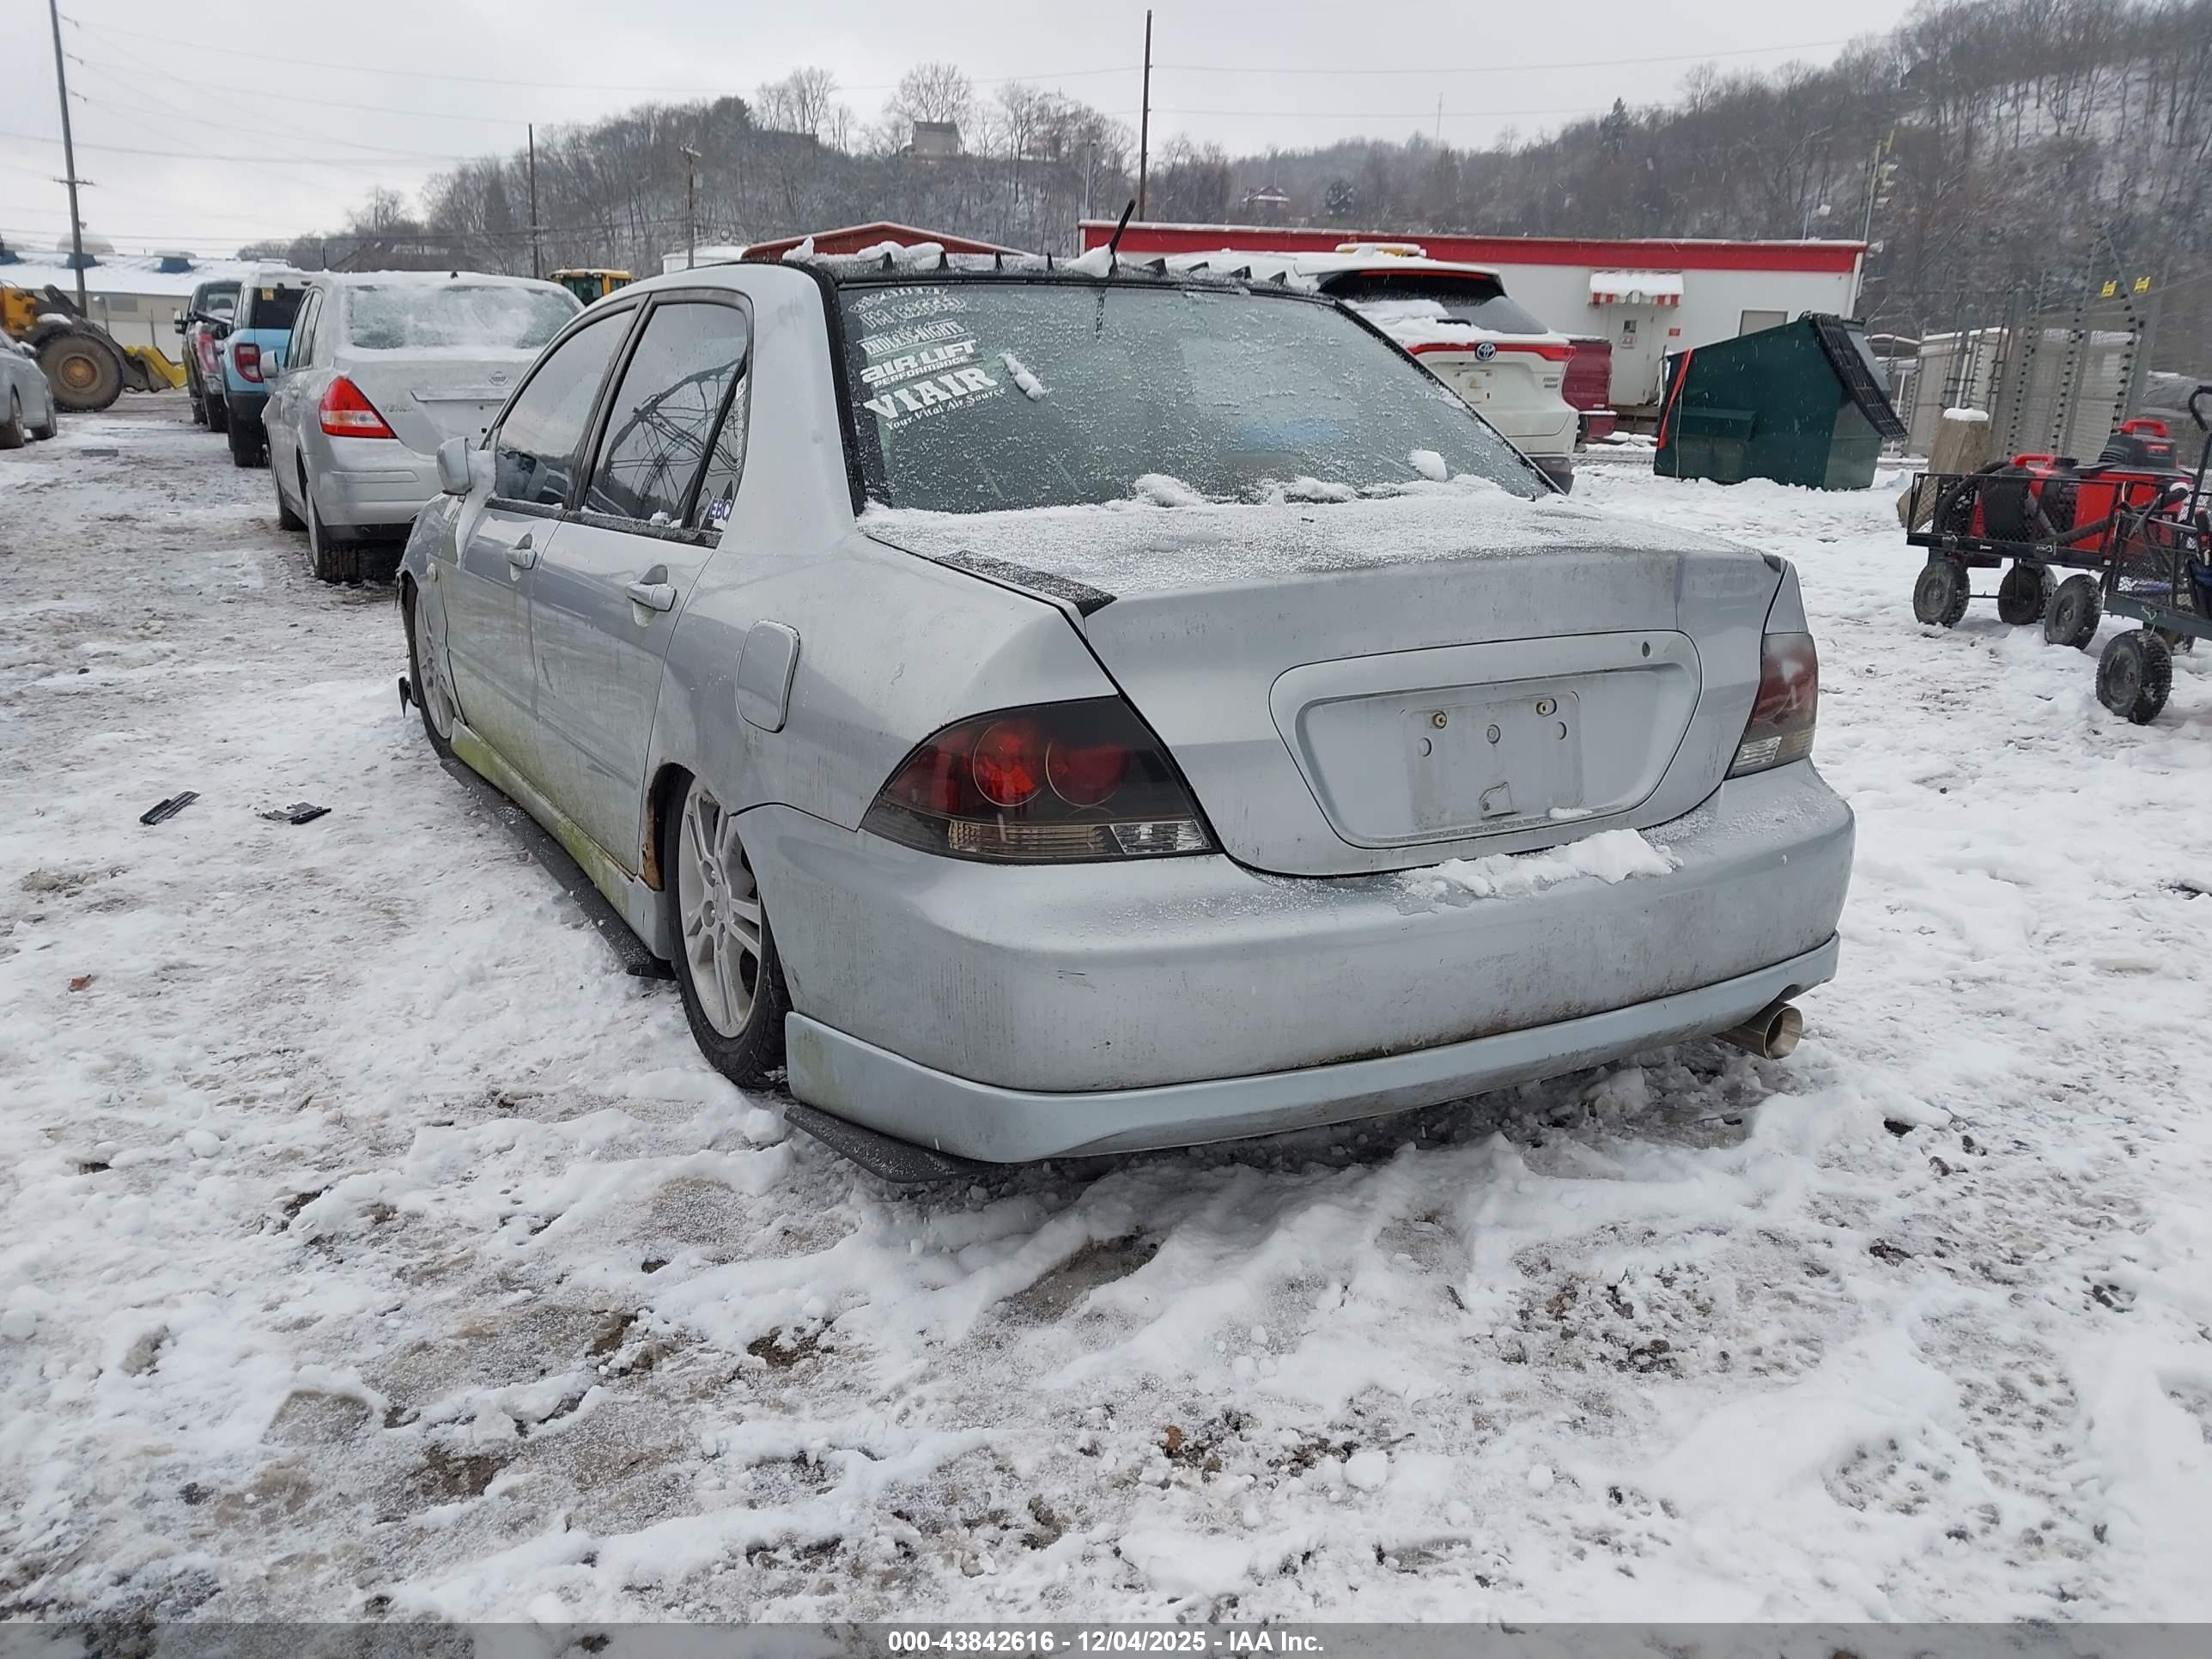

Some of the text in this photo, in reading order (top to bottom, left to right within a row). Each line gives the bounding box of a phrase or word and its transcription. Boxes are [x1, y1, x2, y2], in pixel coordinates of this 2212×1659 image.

[915, 320, 965, 342] NIGHTS
[920, 339, 977, 365] LIFT
[863, 368, 999, 421] VIAIR
[886, 386, 1007, 431] Your Vital Air Source
